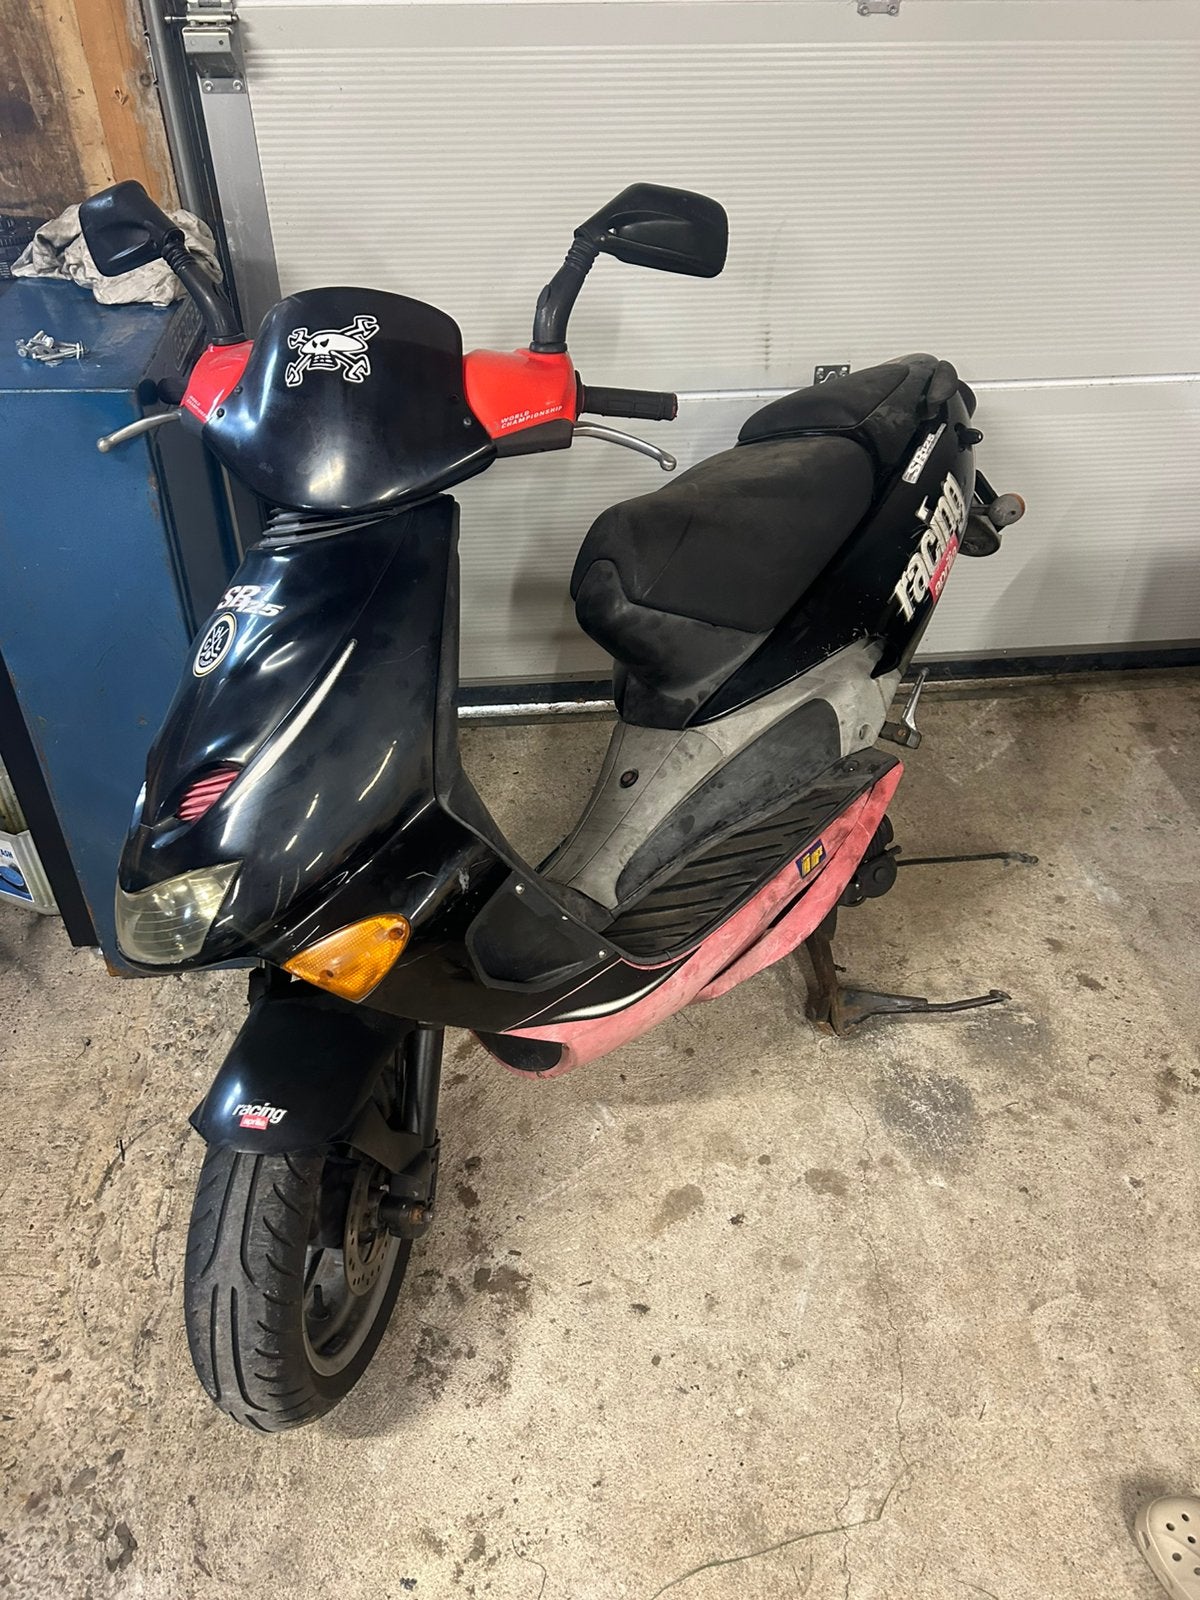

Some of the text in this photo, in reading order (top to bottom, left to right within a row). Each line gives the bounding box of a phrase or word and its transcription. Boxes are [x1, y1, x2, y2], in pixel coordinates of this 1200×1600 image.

[501, 410, 530, 424] WORLD
[501, 405, 563, 429] CHAMPIONSHIP
[890, 472, 965, 622] racing
[232, 1102, 288, 1124] racing
